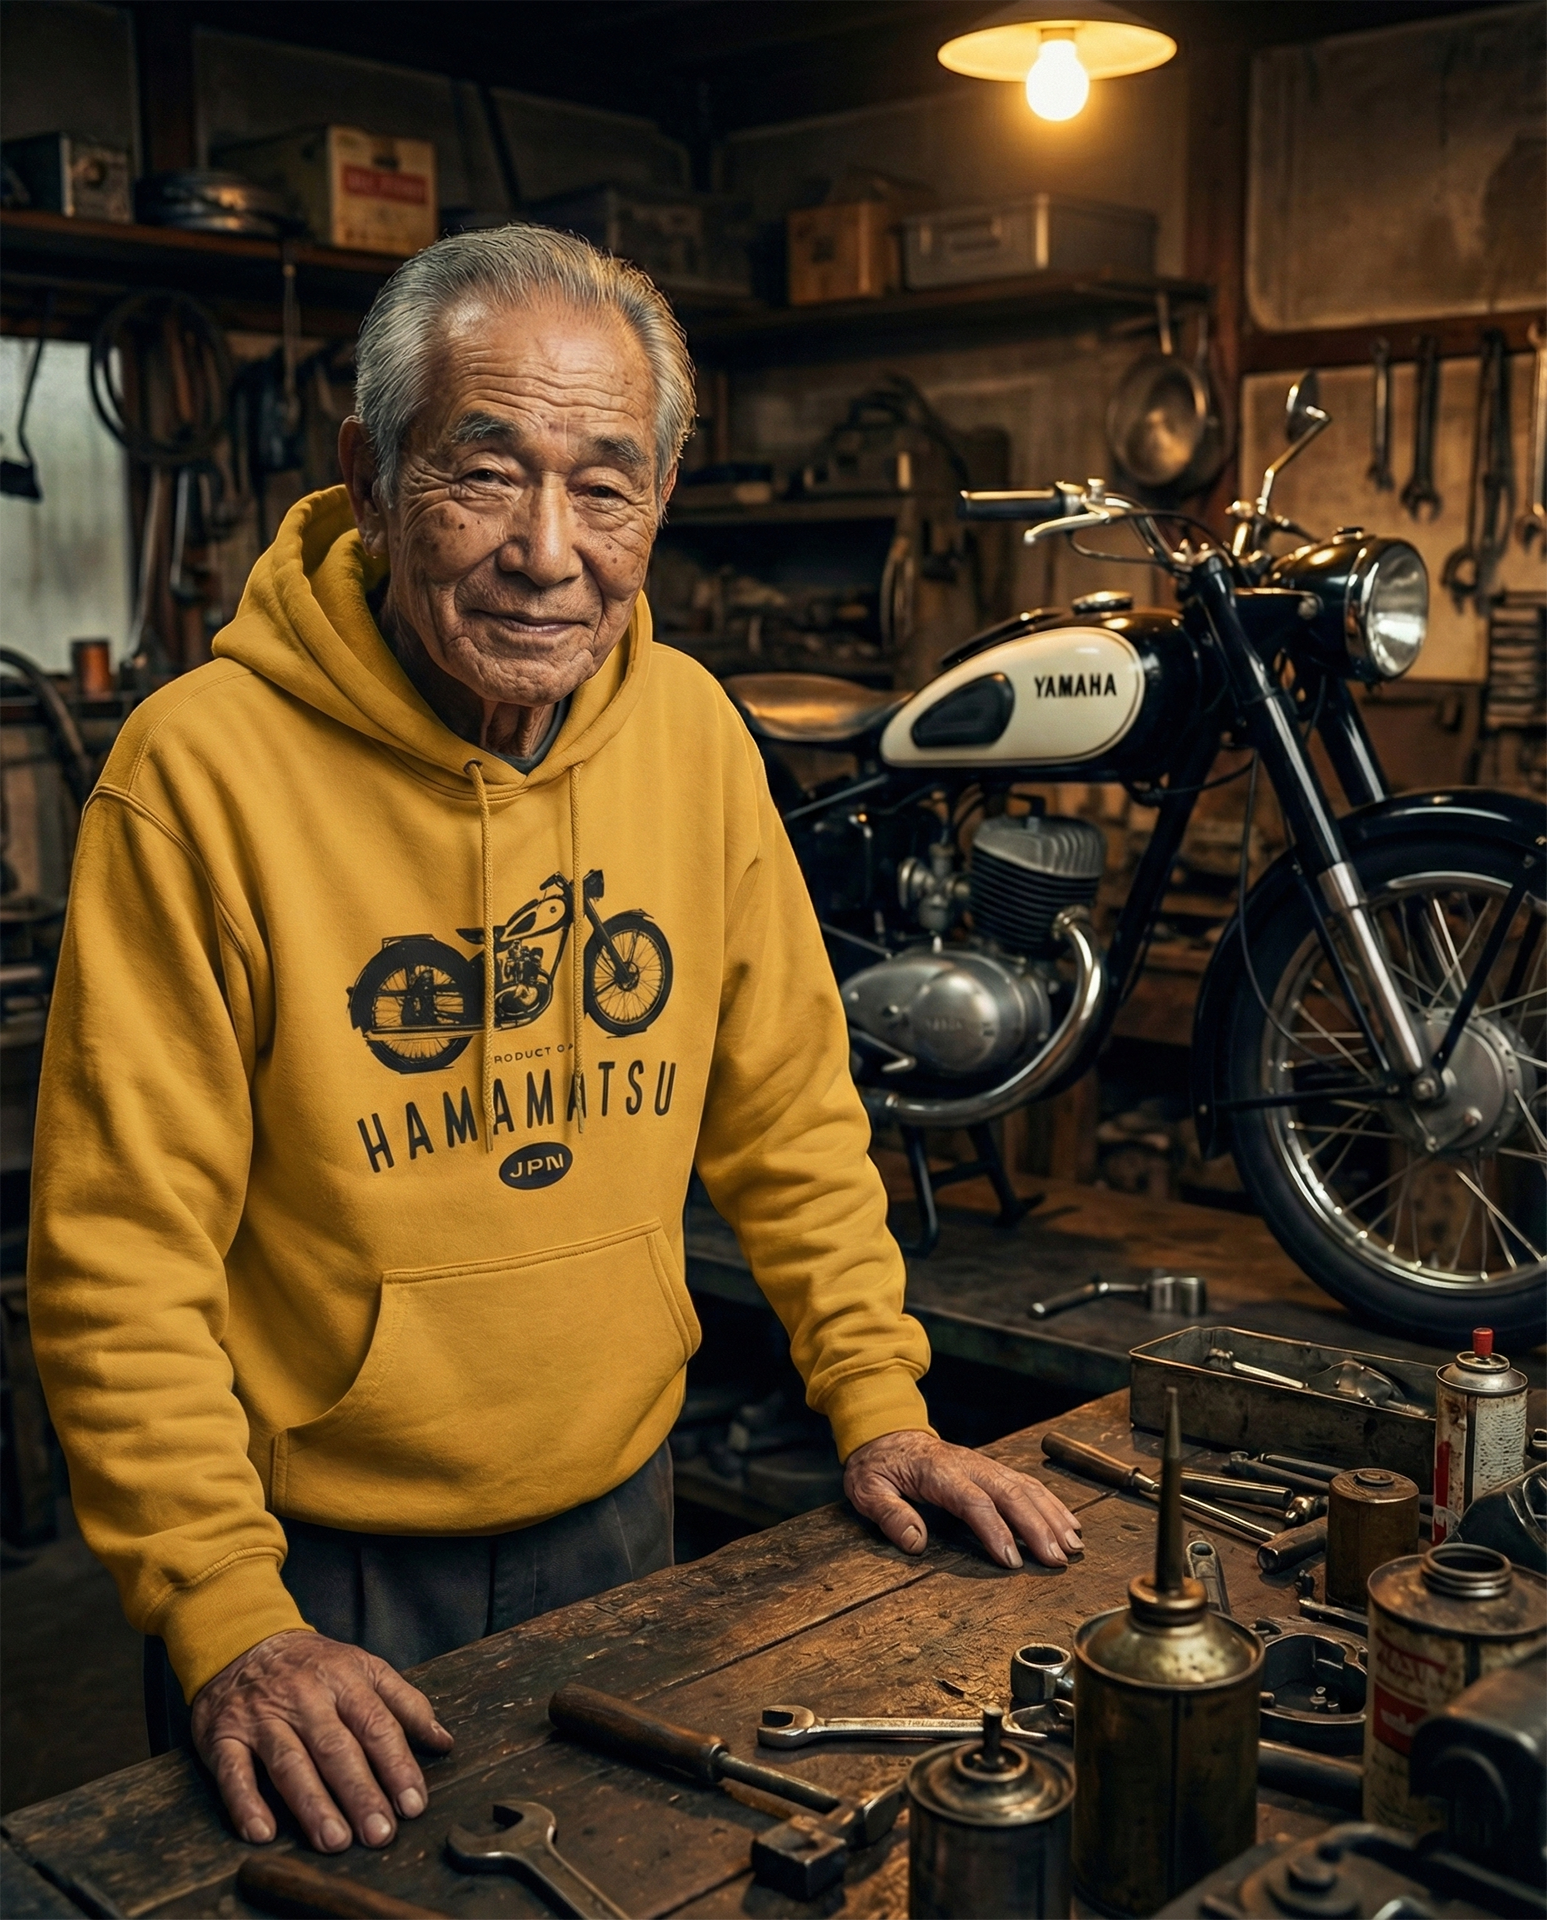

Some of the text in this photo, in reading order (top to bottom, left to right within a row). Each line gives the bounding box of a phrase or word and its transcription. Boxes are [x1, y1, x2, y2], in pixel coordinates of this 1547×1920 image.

[1034, 673, 1117, 698] YAMAHA
[494, 1047, 551, 1064] RODUCT
[357, 1059, 677, 1173] HAMAMATSU
[509, 1153, 565, 1178] JPN
